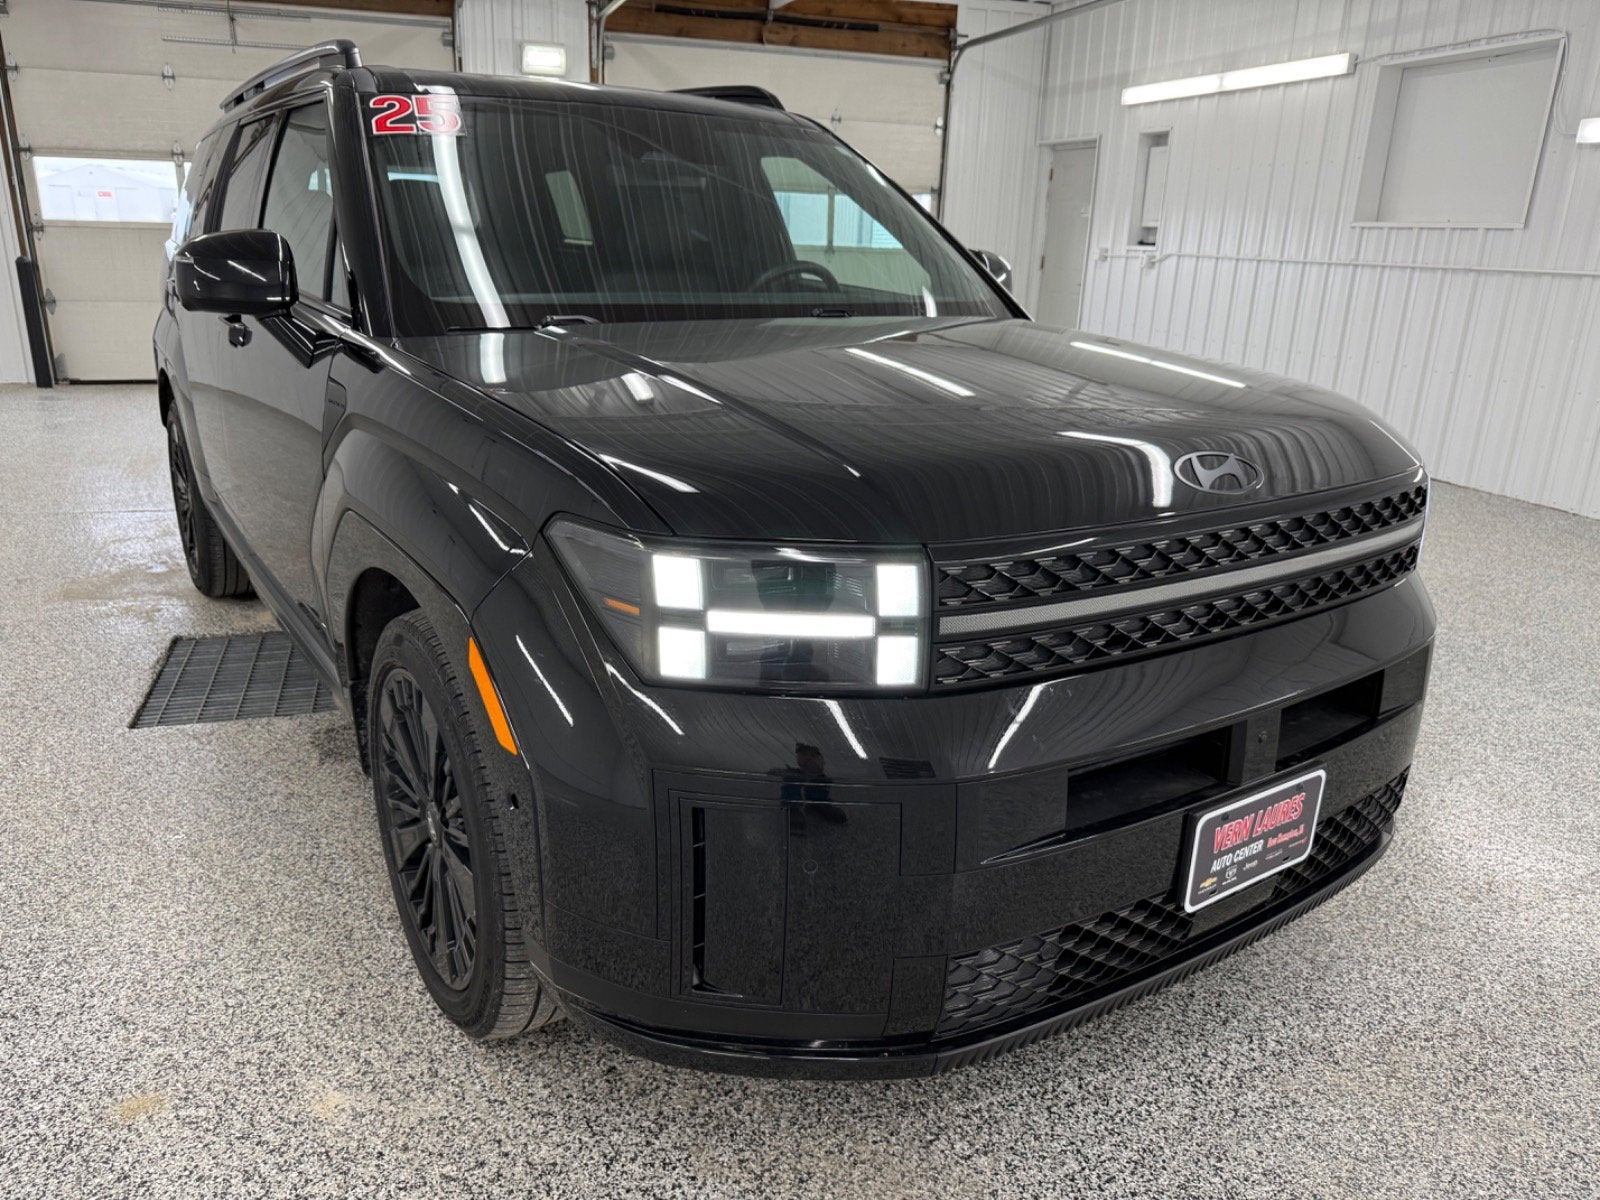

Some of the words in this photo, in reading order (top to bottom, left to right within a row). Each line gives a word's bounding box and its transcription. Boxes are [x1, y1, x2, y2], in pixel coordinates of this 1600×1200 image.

[369, 94, 462, 135] 25
[1214, 813, 1255, 854] VERN
[1252, 793, 1305, 838] LAURES
[1210, 852, 1233, 874] AUTO
[1233, 839, 1264, 863] CENTER
